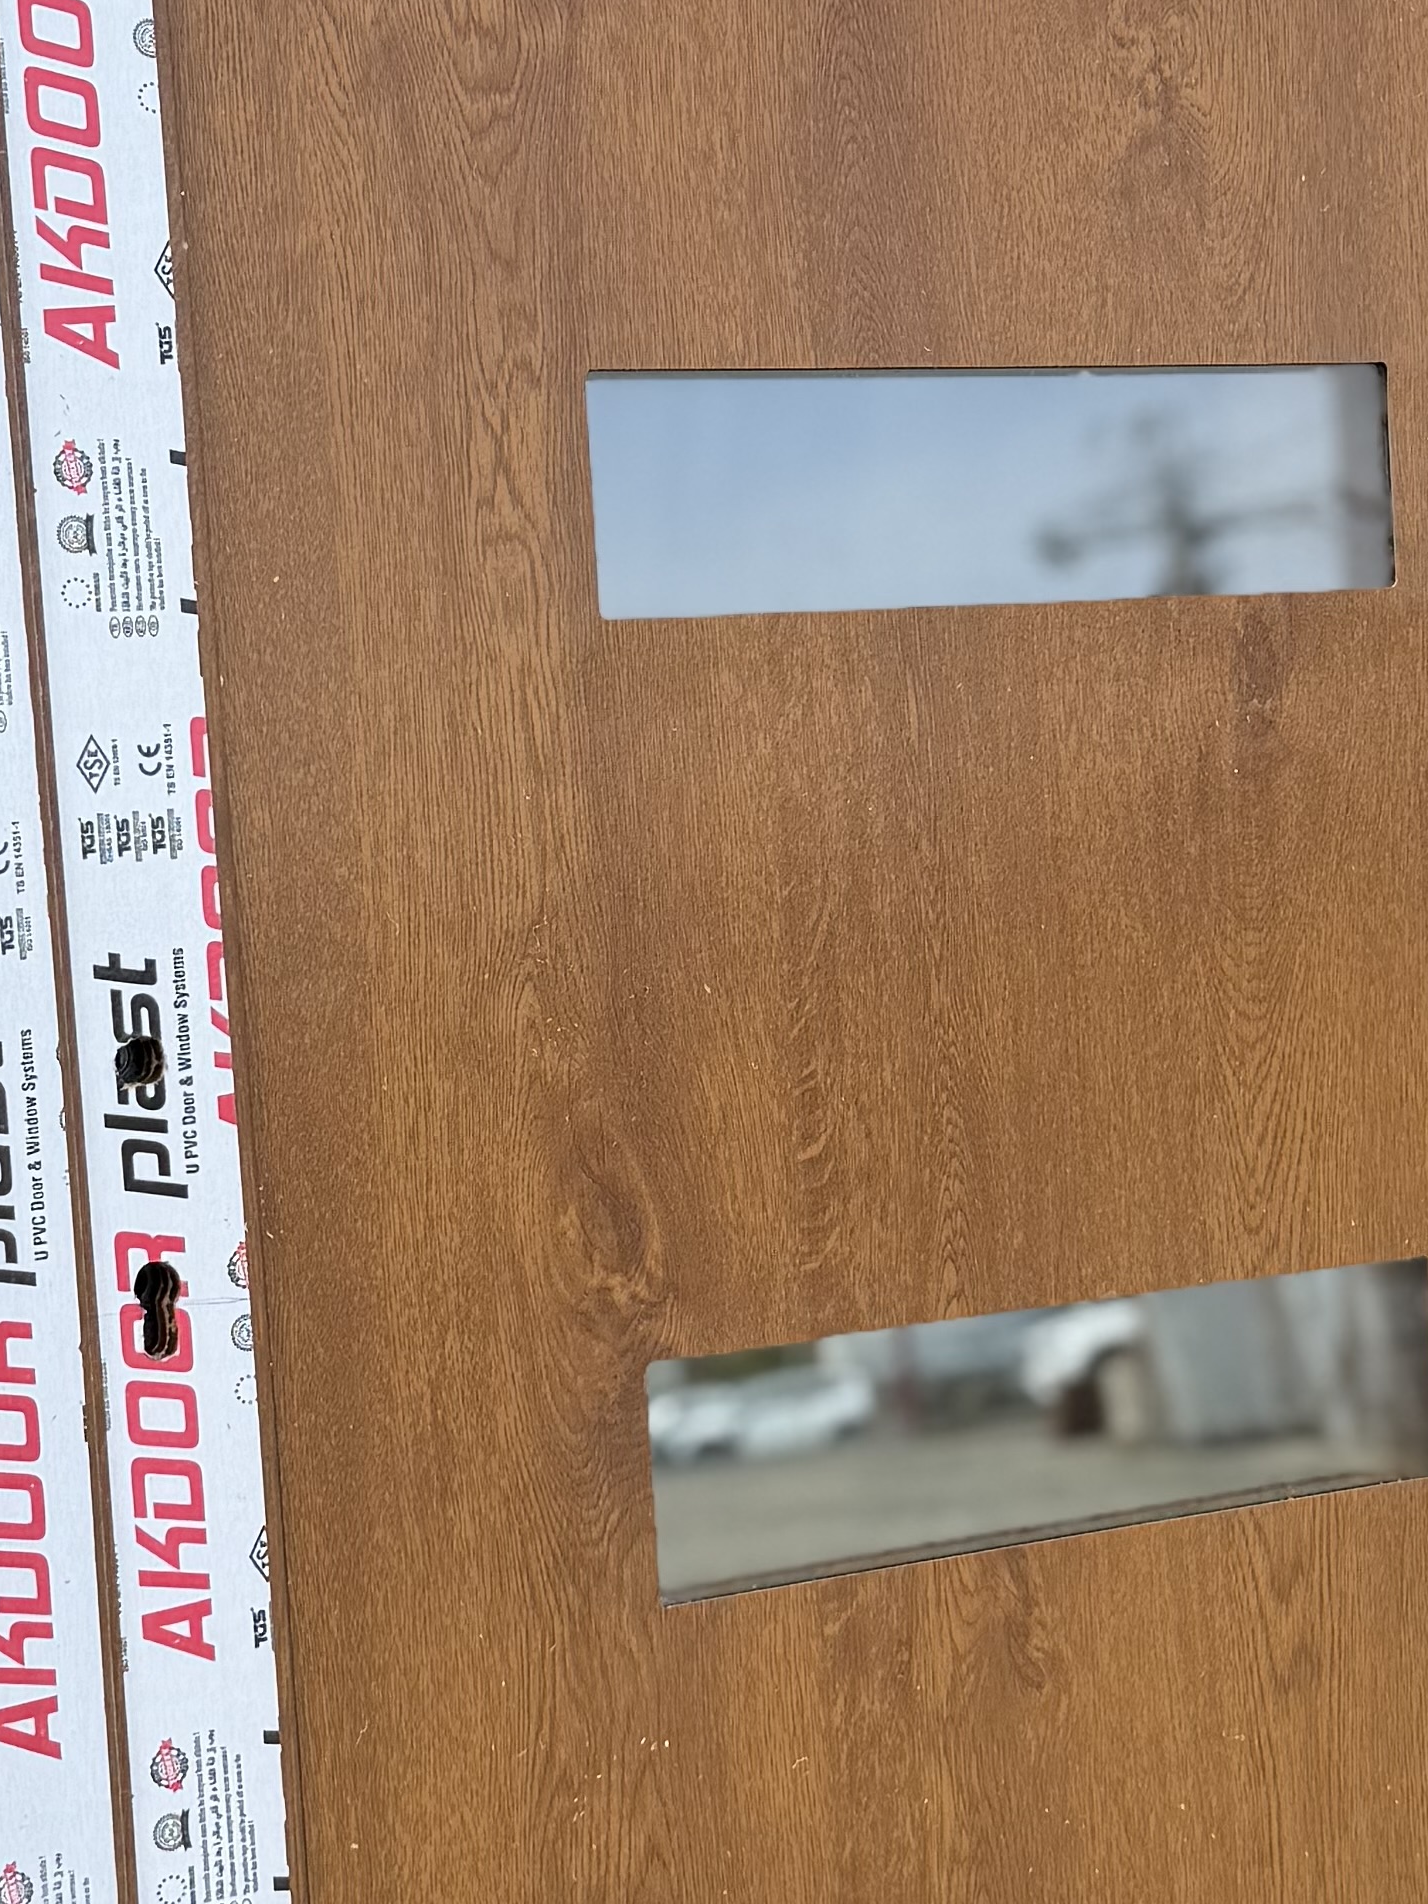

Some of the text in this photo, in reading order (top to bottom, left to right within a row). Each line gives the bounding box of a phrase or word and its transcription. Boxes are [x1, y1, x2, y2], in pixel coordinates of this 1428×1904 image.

[20, 1028, 49, 1261] U PVC Door & Window Systems
[172, 947, 200, 1175] U PVC Door & Window Systems
